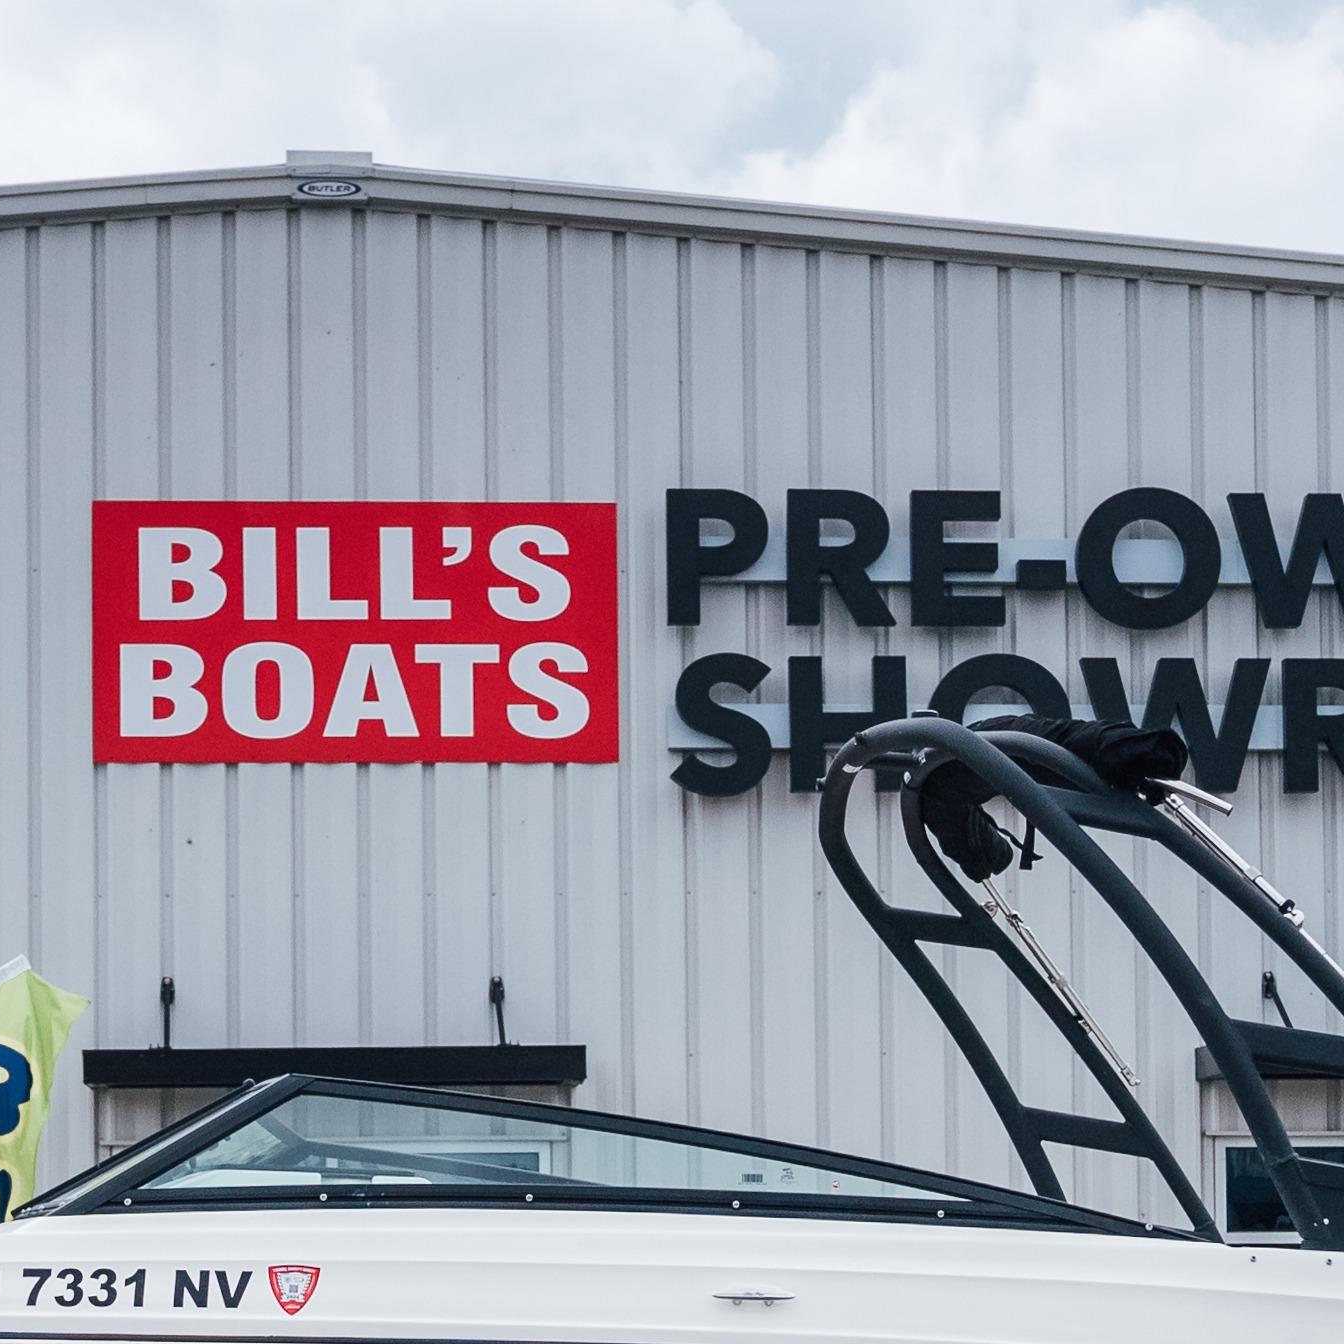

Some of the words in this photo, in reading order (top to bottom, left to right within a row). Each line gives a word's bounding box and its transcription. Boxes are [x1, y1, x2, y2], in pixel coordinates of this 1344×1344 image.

[137, 524, 572, 622] BILL'S
[119, 641, 590, 739] BOATS
[22, 1268, 146, 1307] 7331
[173, 1270, 253, 1308] NV
